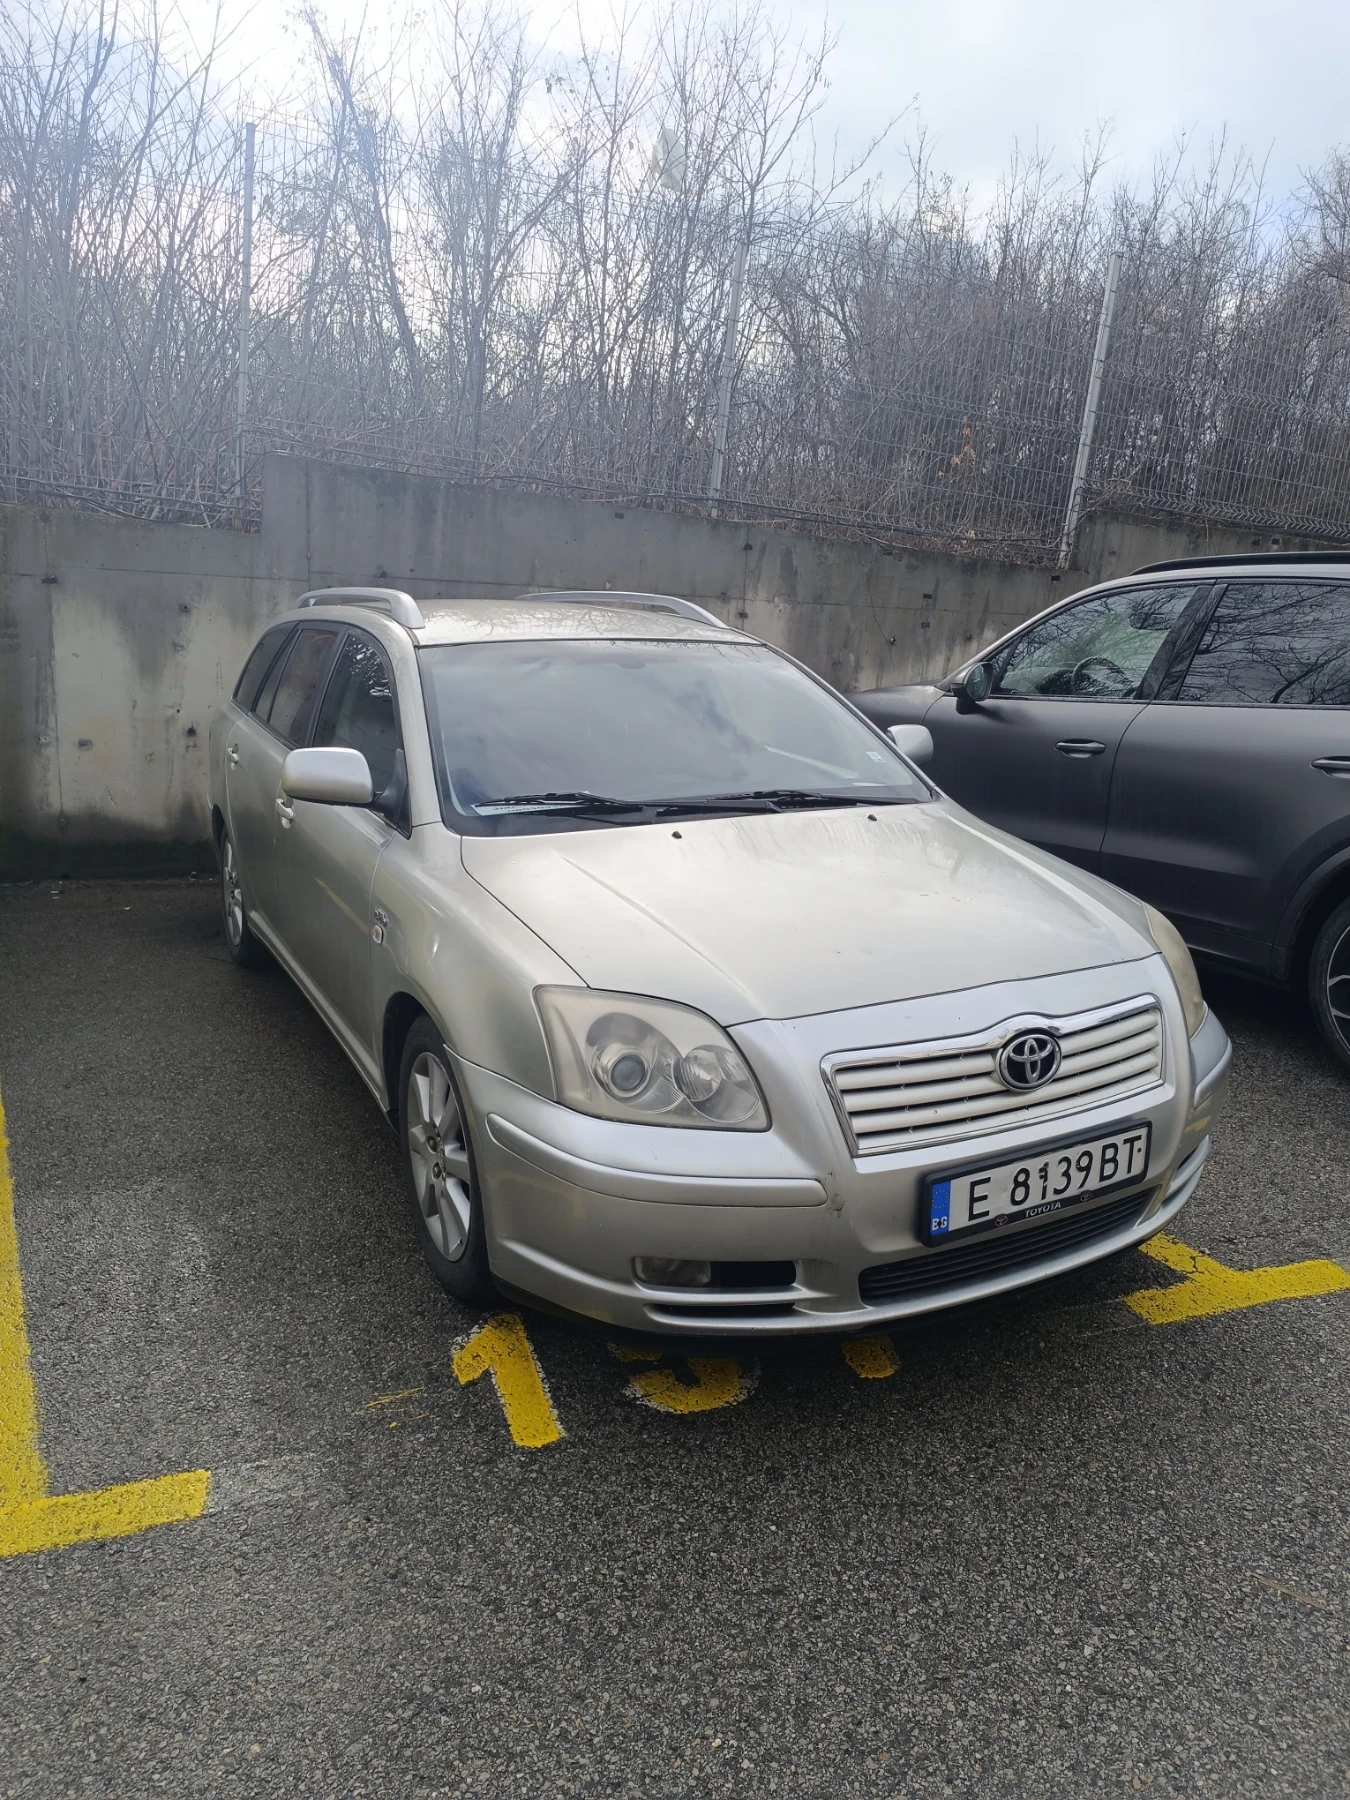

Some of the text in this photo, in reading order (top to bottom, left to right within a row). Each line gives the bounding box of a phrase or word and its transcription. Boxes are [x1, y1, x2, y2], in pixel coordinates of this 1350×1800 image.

[968, 1176, 991, 1222] E
[1025, 1201, 1061, 1218] TOYOTA
[931, 1216, 948, 1231] BG
